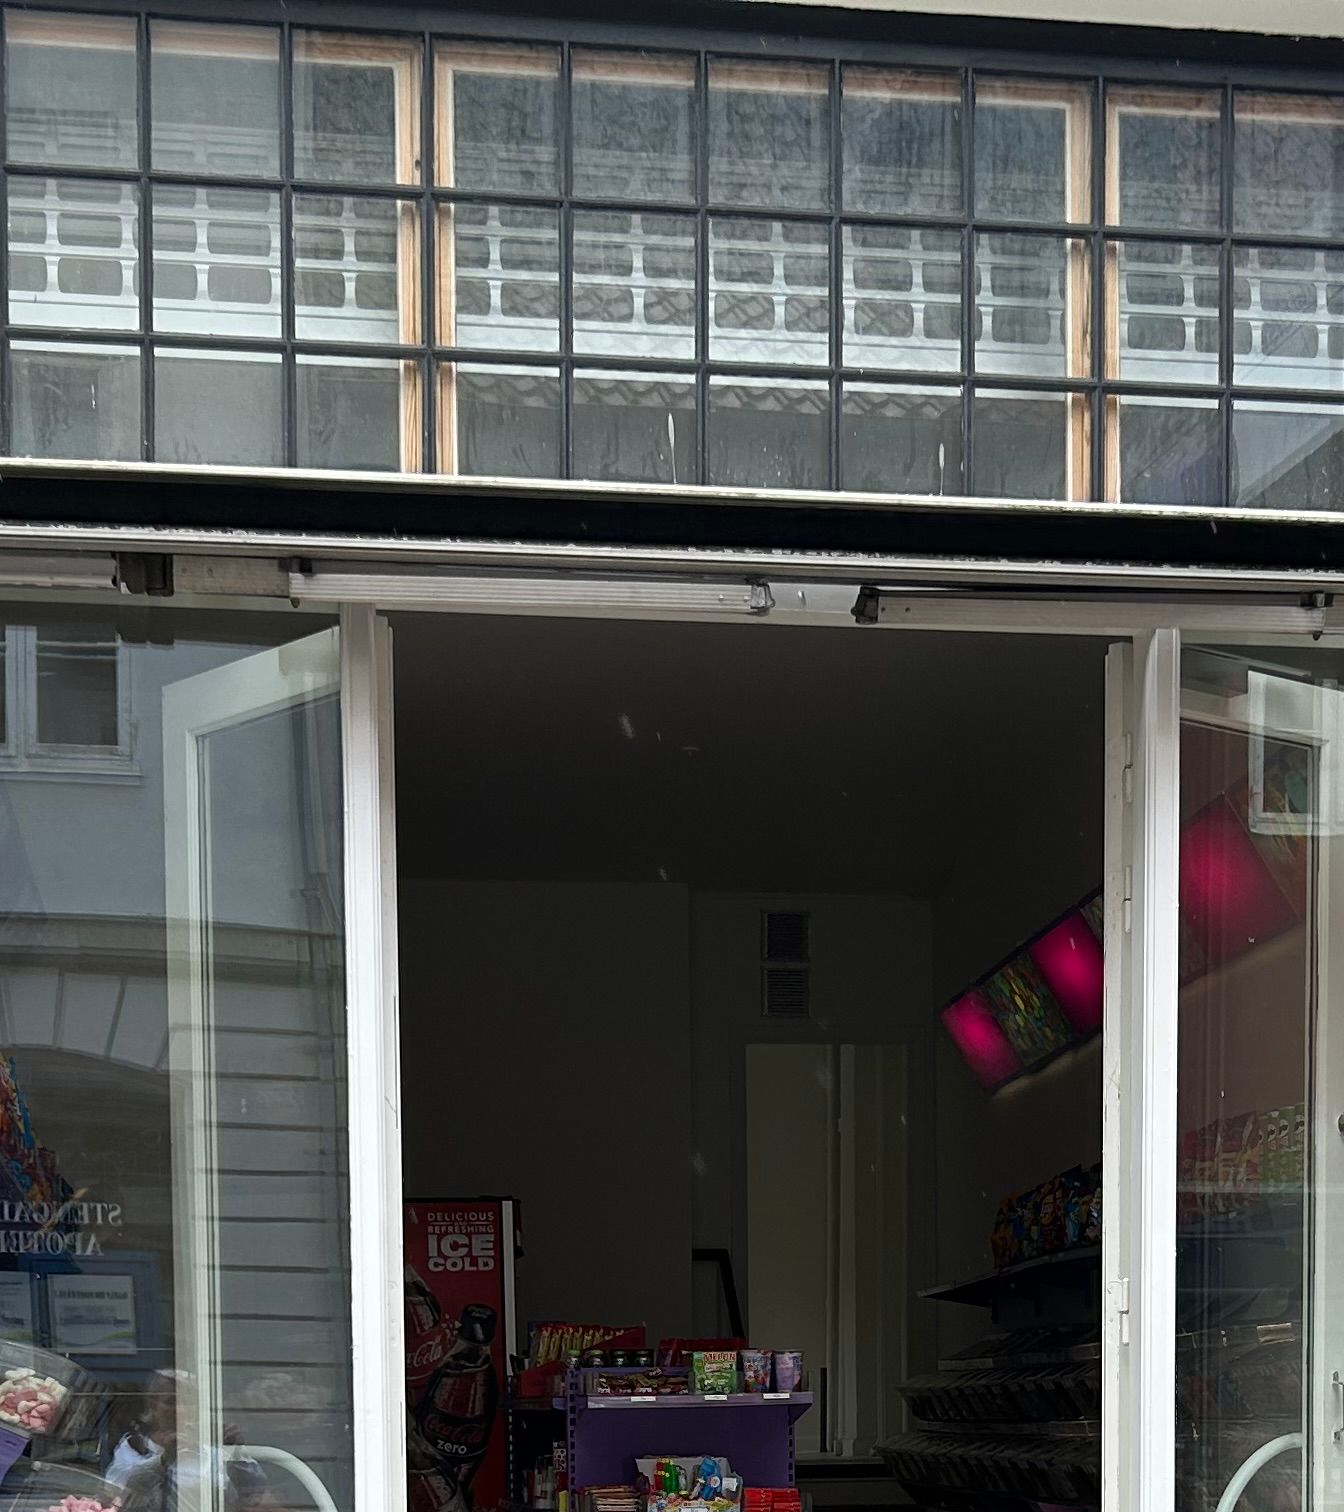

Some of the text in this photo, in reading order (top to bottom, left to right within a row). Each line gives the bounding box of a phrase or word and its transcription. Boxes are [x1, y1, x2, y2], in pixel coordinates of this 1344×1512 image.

[427, 1211, 495, 1222] DELICIOUS
[427, 1225, 495, 1234] REFRESHING
[427, 1233, 495, 1257] ICE
[427, 1256, 495, 1272] COLD
[436, 1439, 467, 1454] zero
